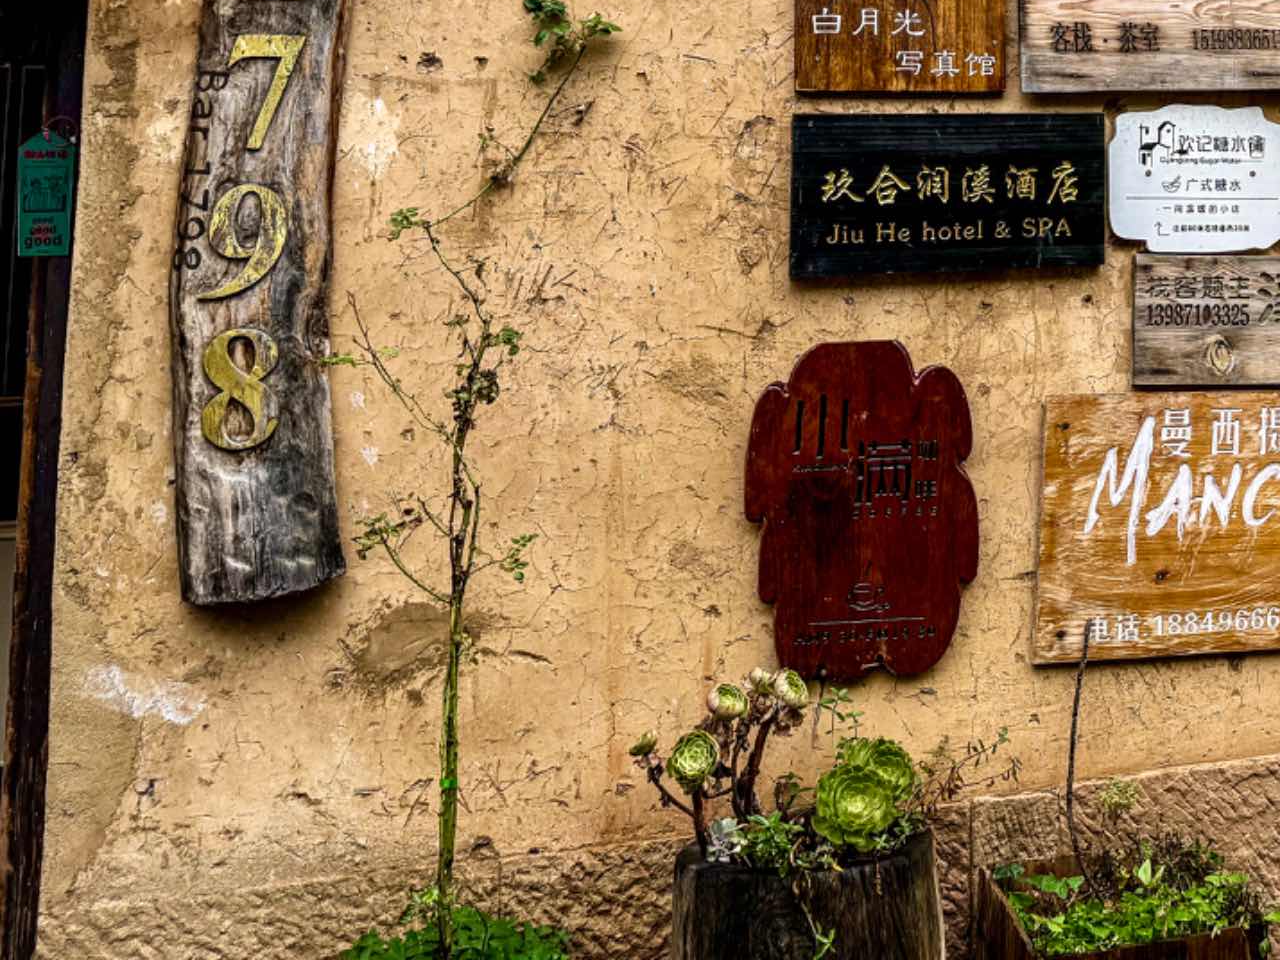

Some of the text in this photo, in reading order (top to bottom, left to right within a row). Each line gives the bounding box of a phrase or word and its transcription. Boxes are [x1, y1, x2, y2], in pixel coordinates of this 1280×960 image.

[811, 6, 927, 37] 白月光
[895, 49, 997, 85] 写真馆
[171, 68, 229, 272] Bar 1798
[1186, 178, 1242, 192] 广式糖水
[826, 217, 1073, 245] Jiu He hotel & SPA
[1145, 302, 1250, 328] 13987103325
